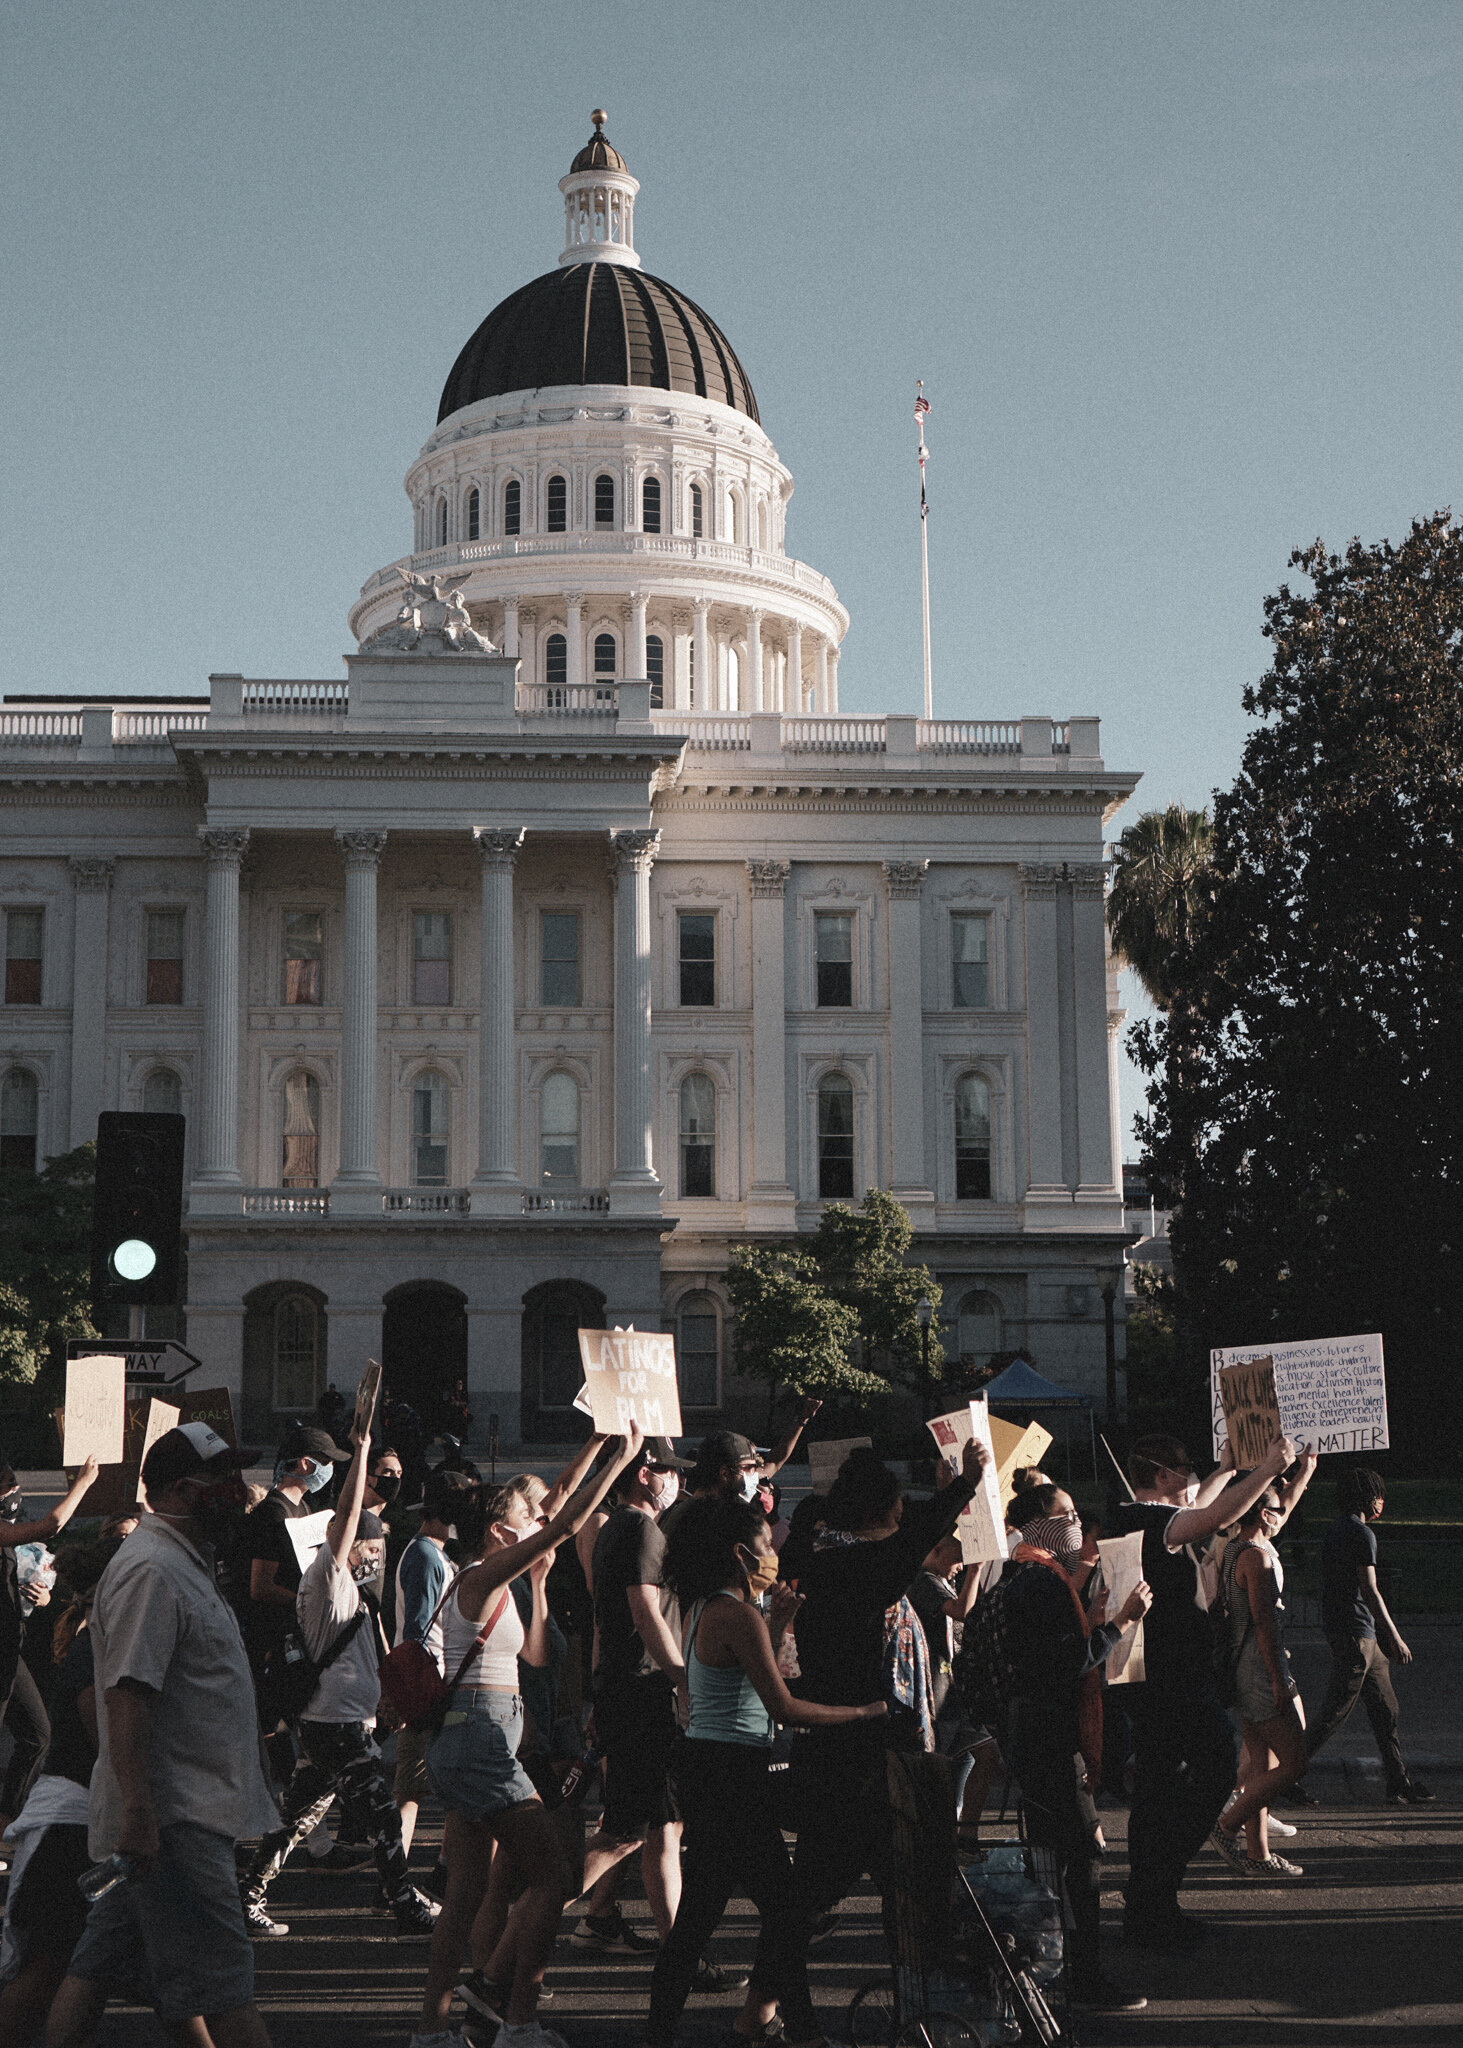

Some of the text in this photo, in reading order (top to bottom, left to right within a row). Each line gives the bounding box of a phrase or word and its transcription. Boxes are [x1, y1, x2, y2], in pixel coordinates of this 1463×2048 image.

[124, 1353, 161, 1371] WAY
[582, 1335, 674, 1379] LATINOS
[1228, 1352, 1267, 1363] dreams
[1275, 1358, 1335, 1372] eighborhoods
[618, 1370, 649, 1394] FOR
[191, 1409, 230, 1421] GOALS
[1318, 1426, 1385, 1452] MATTER
